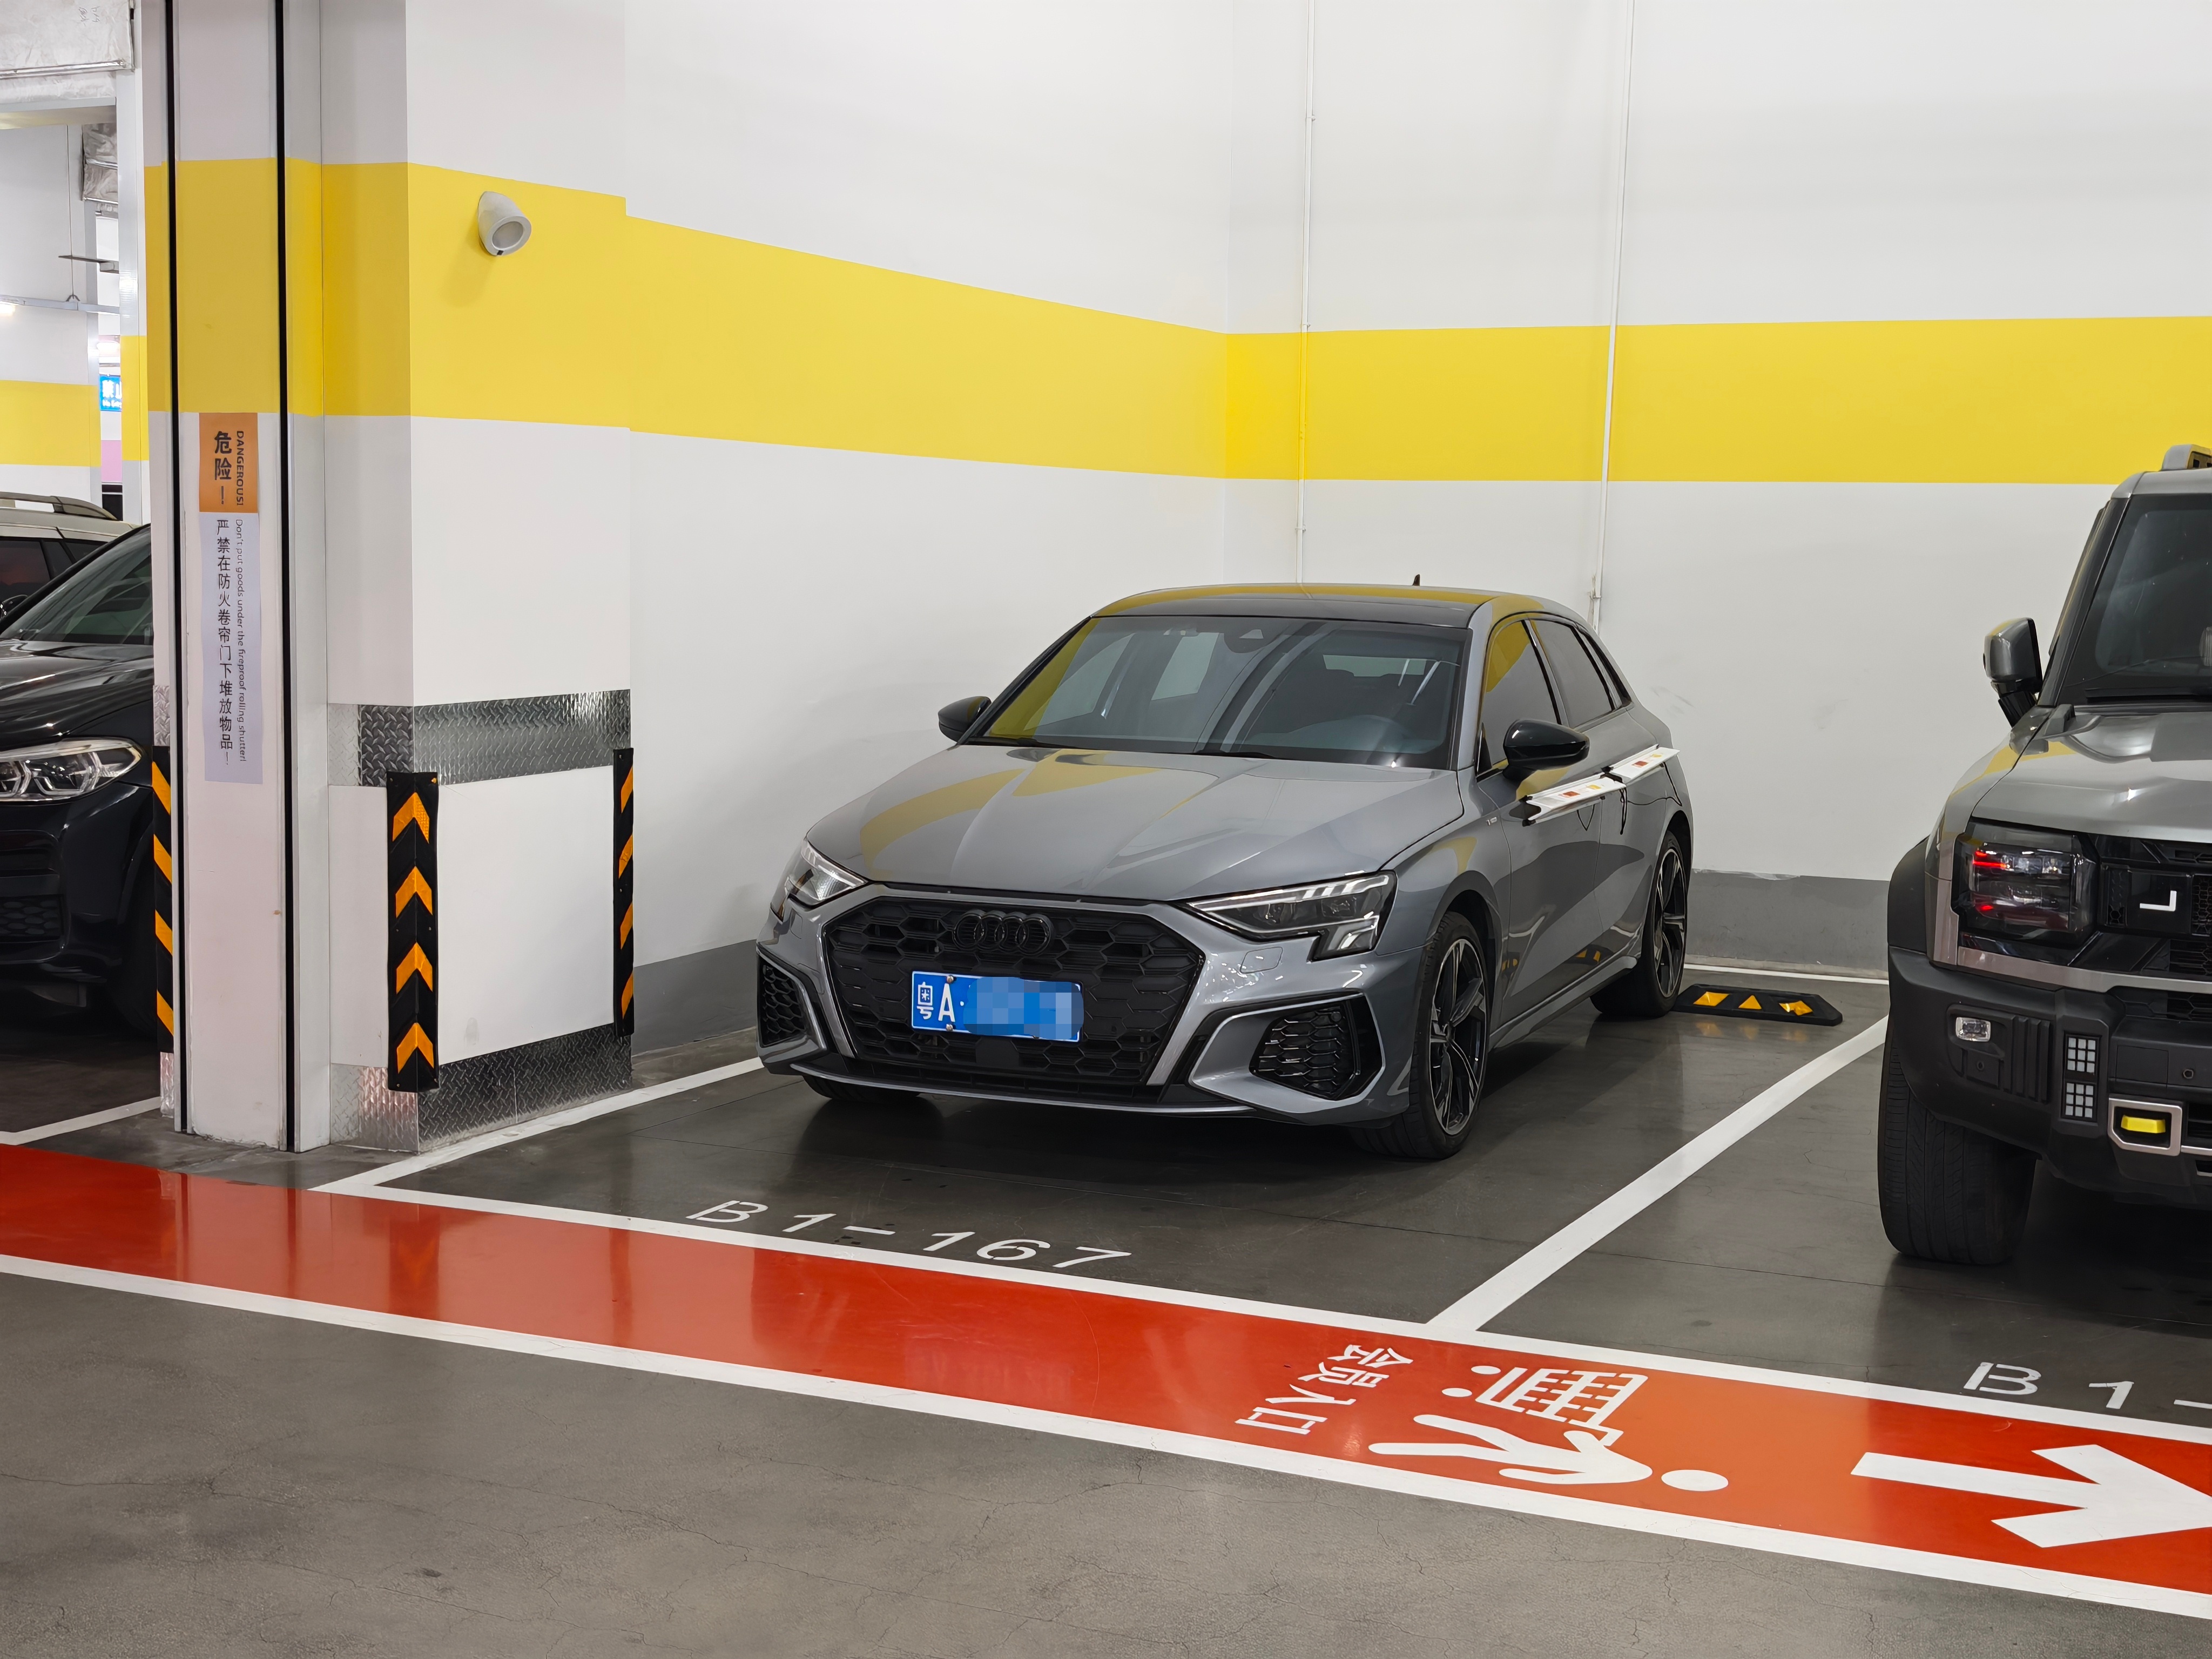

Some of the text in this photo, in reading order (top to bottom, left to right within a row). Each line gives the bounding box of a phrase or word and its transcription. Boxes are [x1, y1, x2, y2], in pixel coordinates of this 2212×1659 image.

[214, 431, 232, 505] 危险！
[236, 430, 244, 506] DANGEROUS!
[235, 519, 244, 546] Don't
[235, 567, 245, 597] goods
[217, 520, 233, 765] 严禁在防火卷帘门下堆放物品！
[237, 649, 246, 691] fireproof
[237, 692, 246, 723] rolling
[238, 725, 247, 762] shutter!
[686, 1200, 1132, 1268] B1-167
[1235, 1344, 1414, 1435] 会员入口
